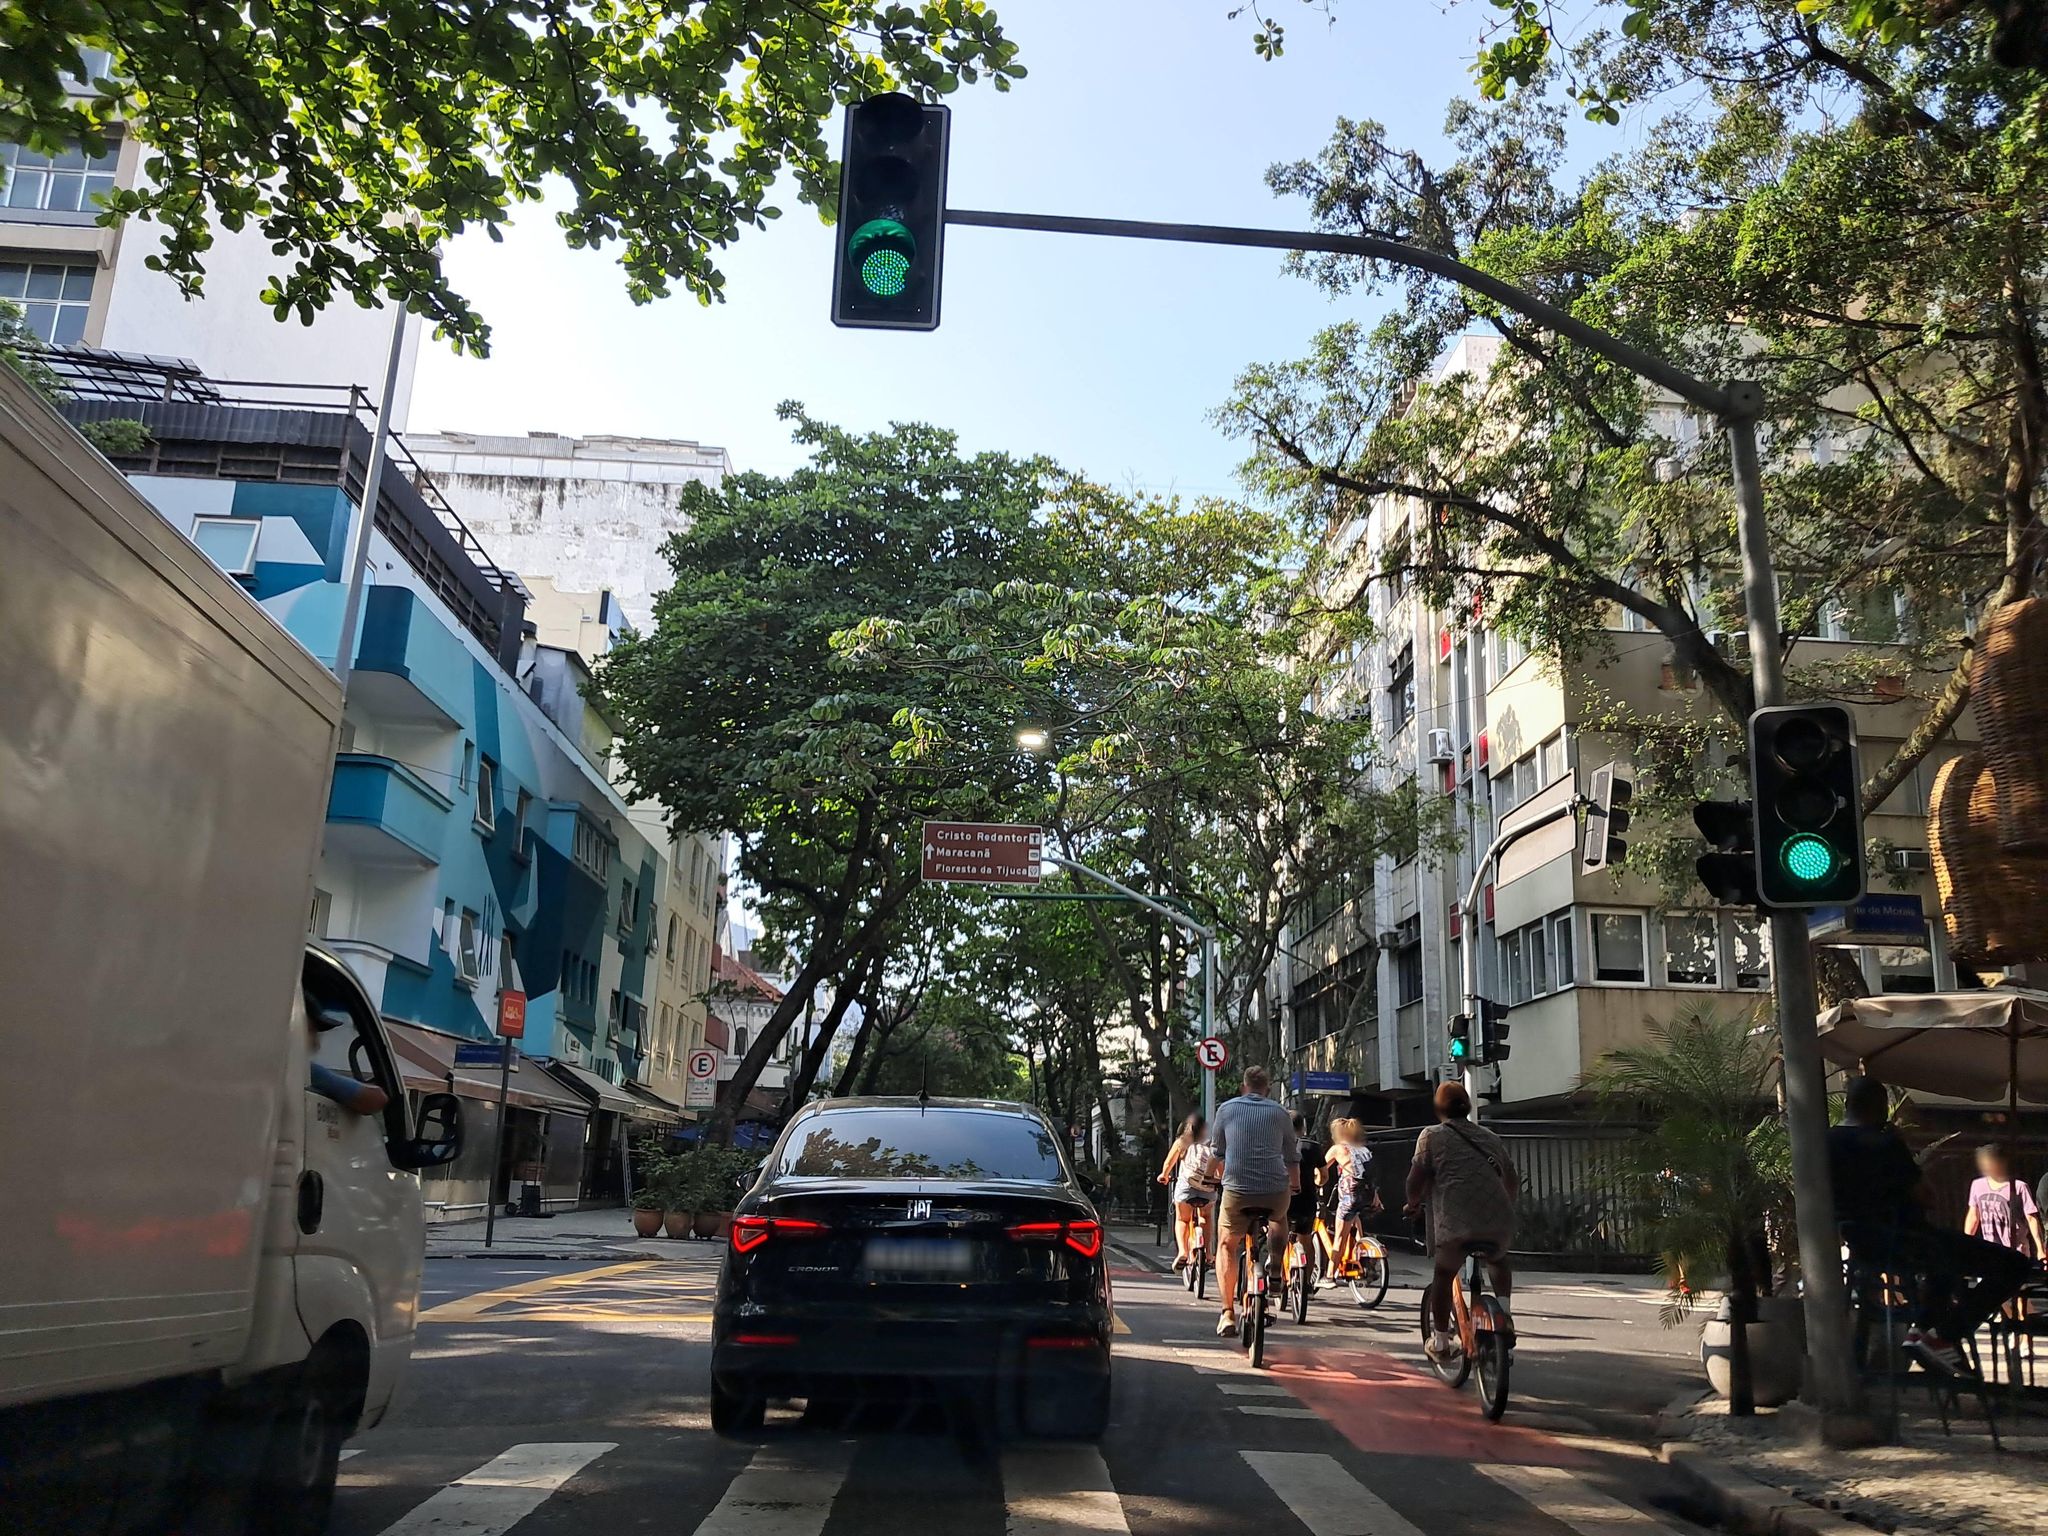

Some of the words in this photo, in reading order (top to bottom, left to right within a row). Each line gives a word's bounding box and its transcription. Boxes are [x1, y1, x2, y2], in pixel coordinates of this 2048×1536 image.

[937, 830, 972, 841] Cristo
[977, 831, 1028, 843] Redentor
[936, 847, 991, 859] Maracanã
[935, 863, 977, 874] Floresta
[980, 864, 992, 874] da
[997, 866, 1028, 877] Tijuca
[1207, 1044, 1218, 1062] E
[698, 1057, 708, 1072] E
[907, 1199, 933, 1220] FIAT
